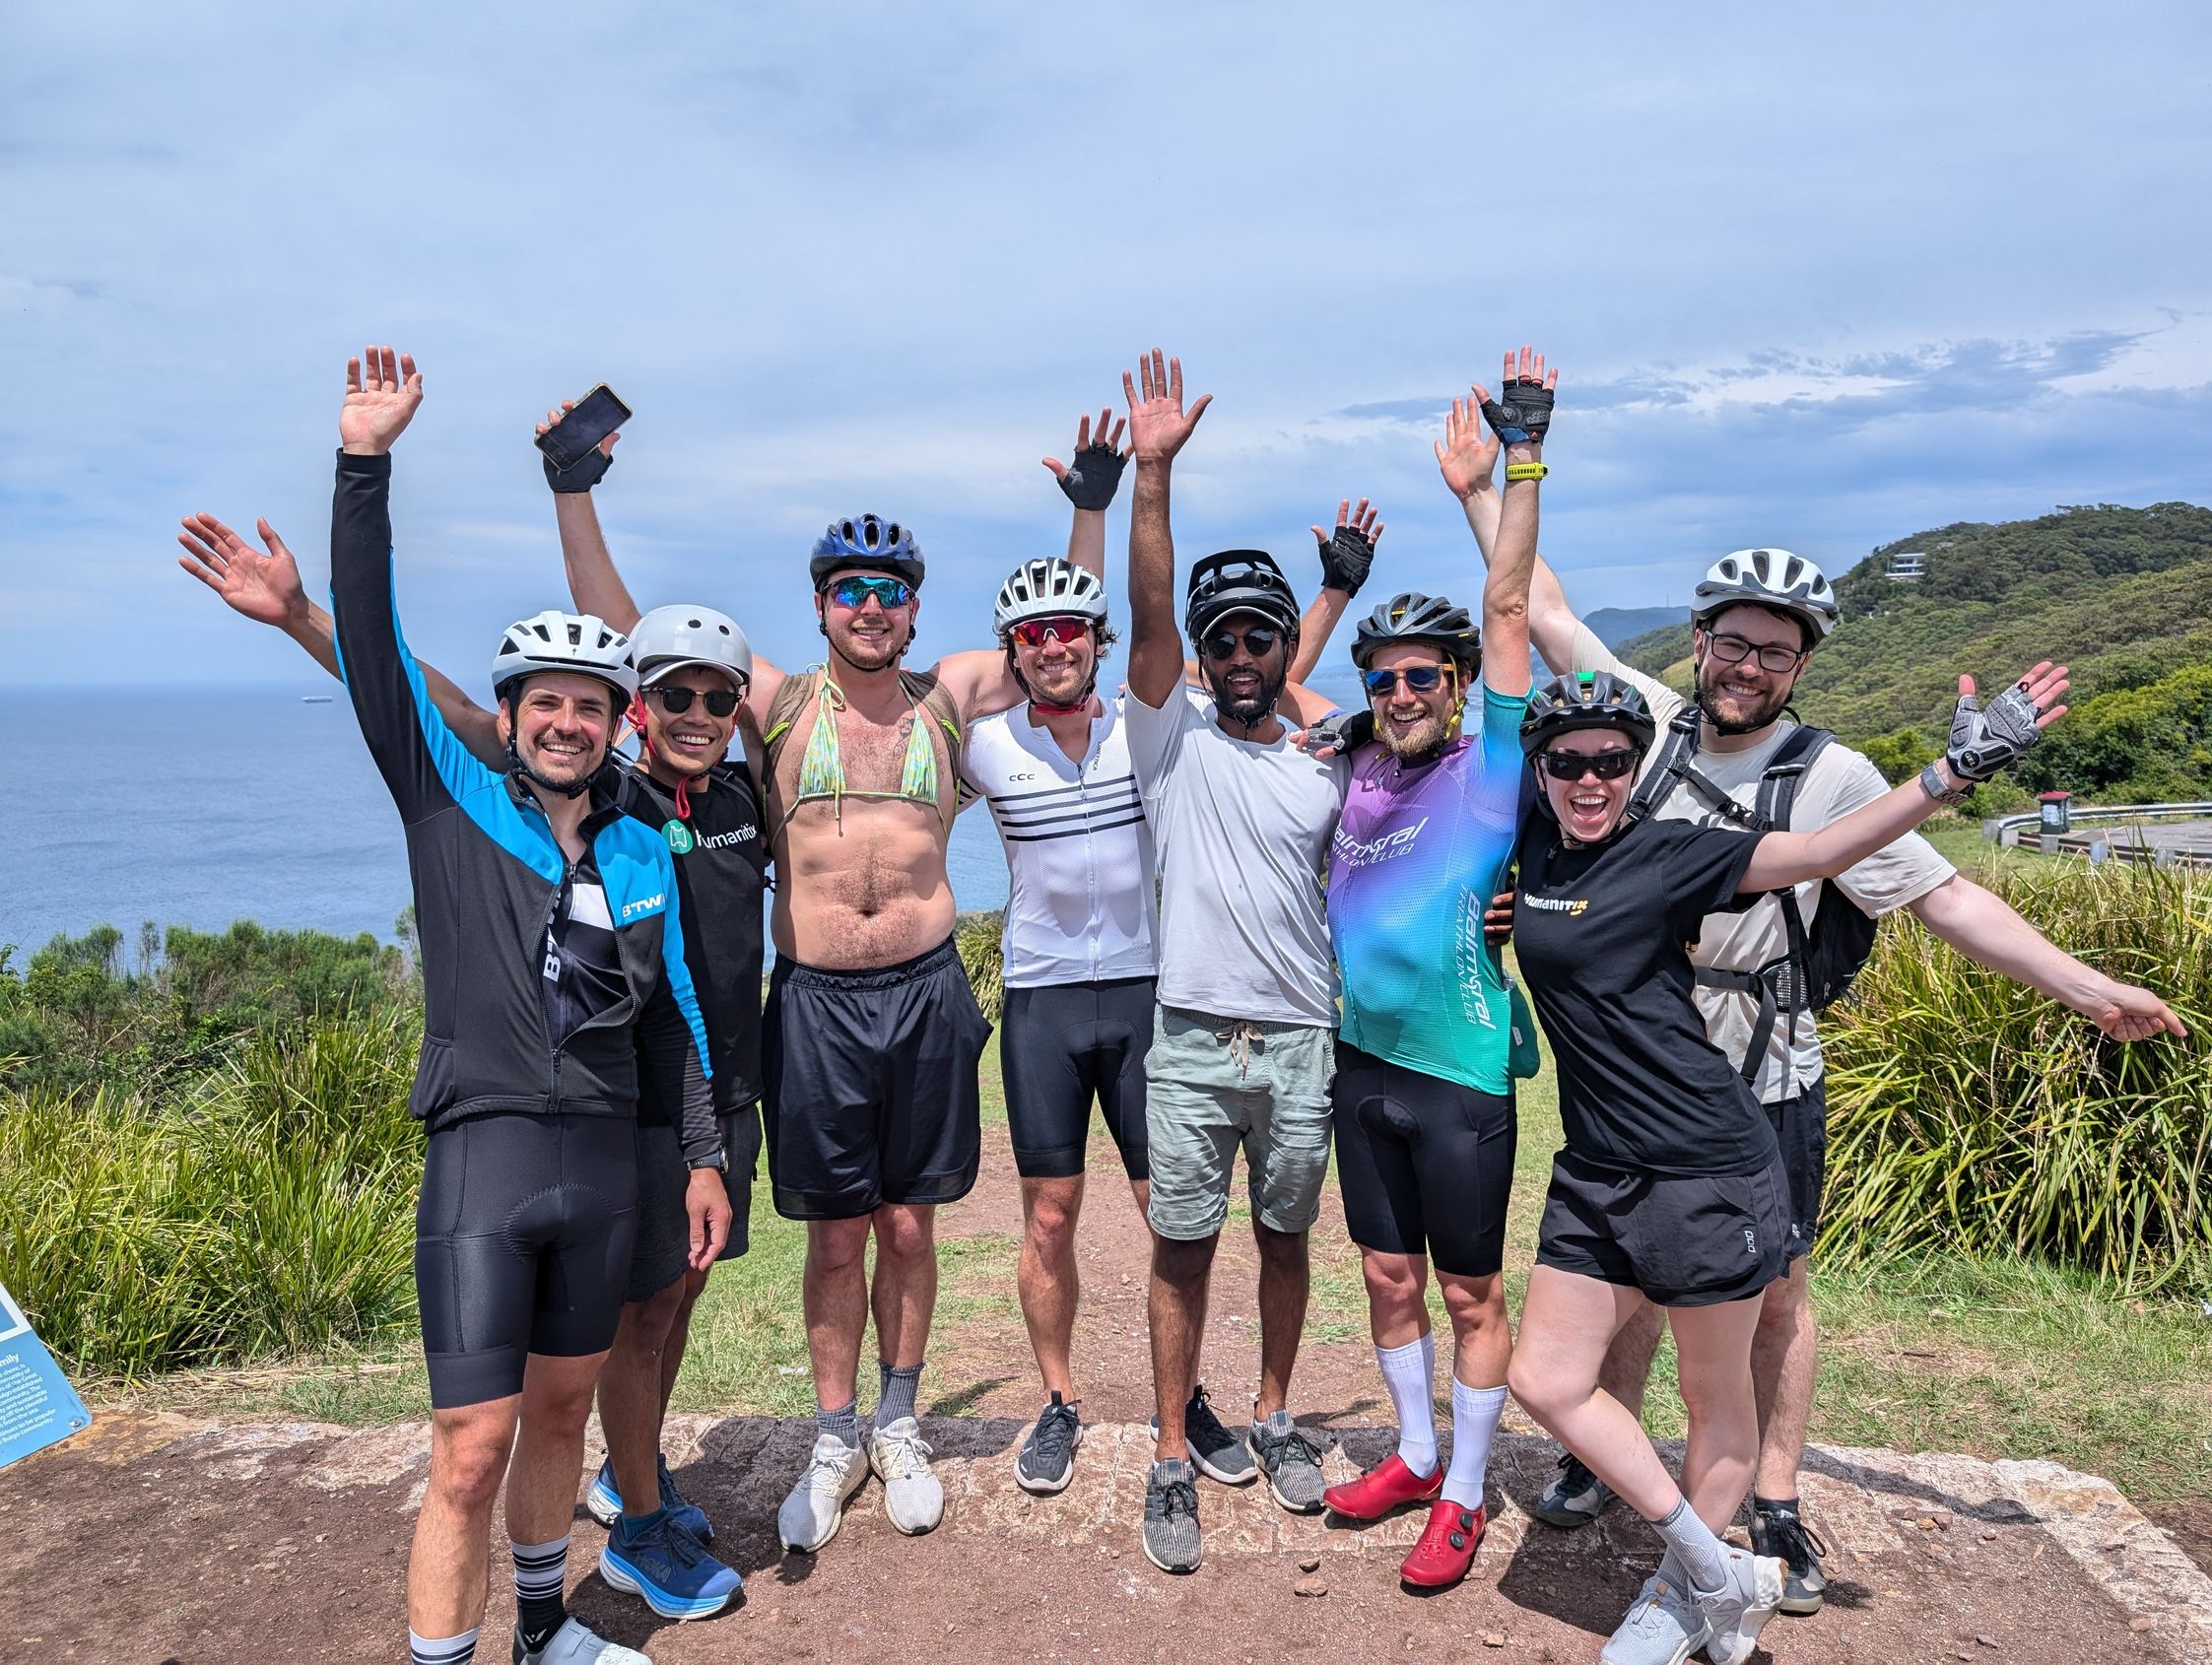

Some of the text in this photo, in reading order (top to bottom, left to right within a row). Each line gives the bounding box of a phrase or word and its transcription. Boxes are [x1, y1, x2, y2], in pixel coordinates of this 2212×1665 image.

[1964, 753, 1976, 767] GEL
[1465, 891, 1497, 1031] Balmoral
[1460, 982, 1477, 1026] CLUB
